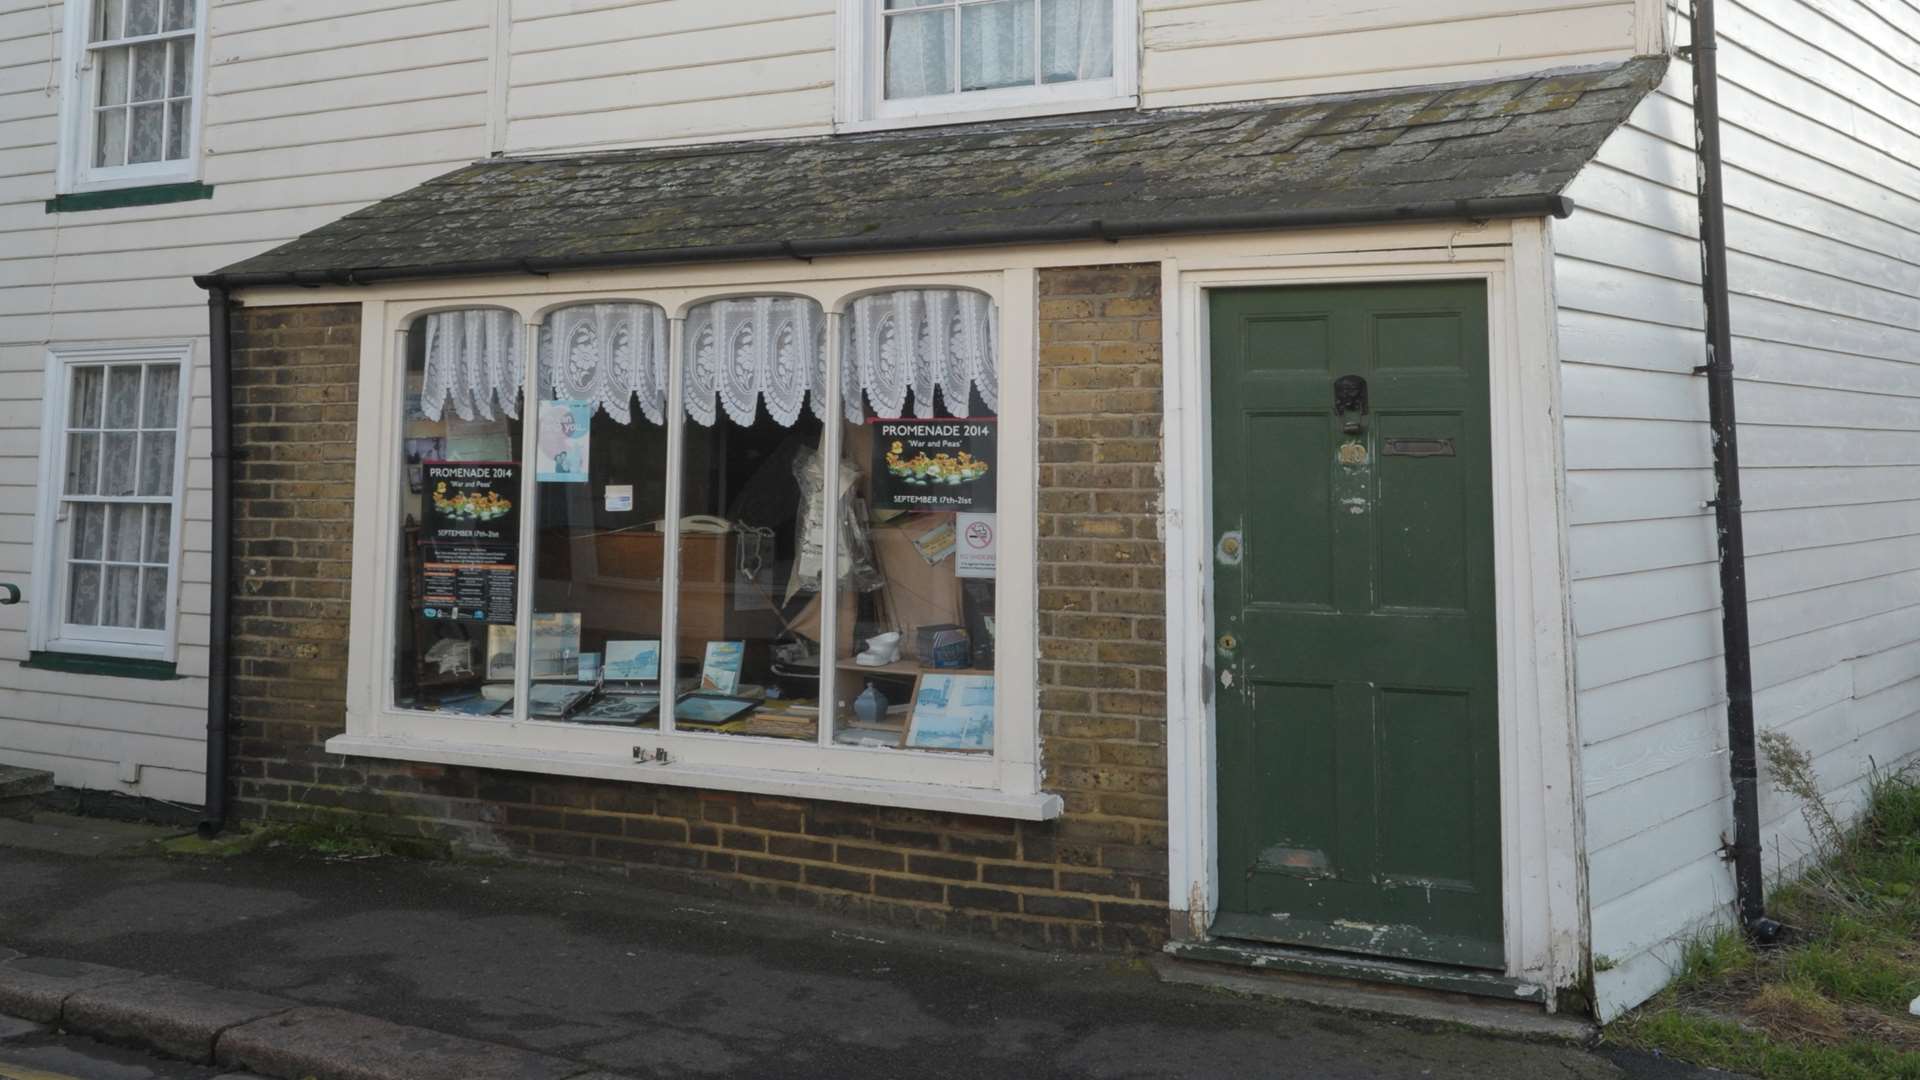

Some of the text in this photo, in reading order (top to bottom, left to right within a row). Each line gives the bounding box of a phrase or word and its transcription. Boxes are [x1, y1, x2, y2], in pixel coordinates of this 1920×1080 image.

[881, 425, 990, 436] PROMENADE 2014
[430, 468, 512, 478] PROMENADE 2014
[893, 495, 972, 504] SEPTEMBER 17th-21st
[437, 529, 473, 537] SEPTEMBER
